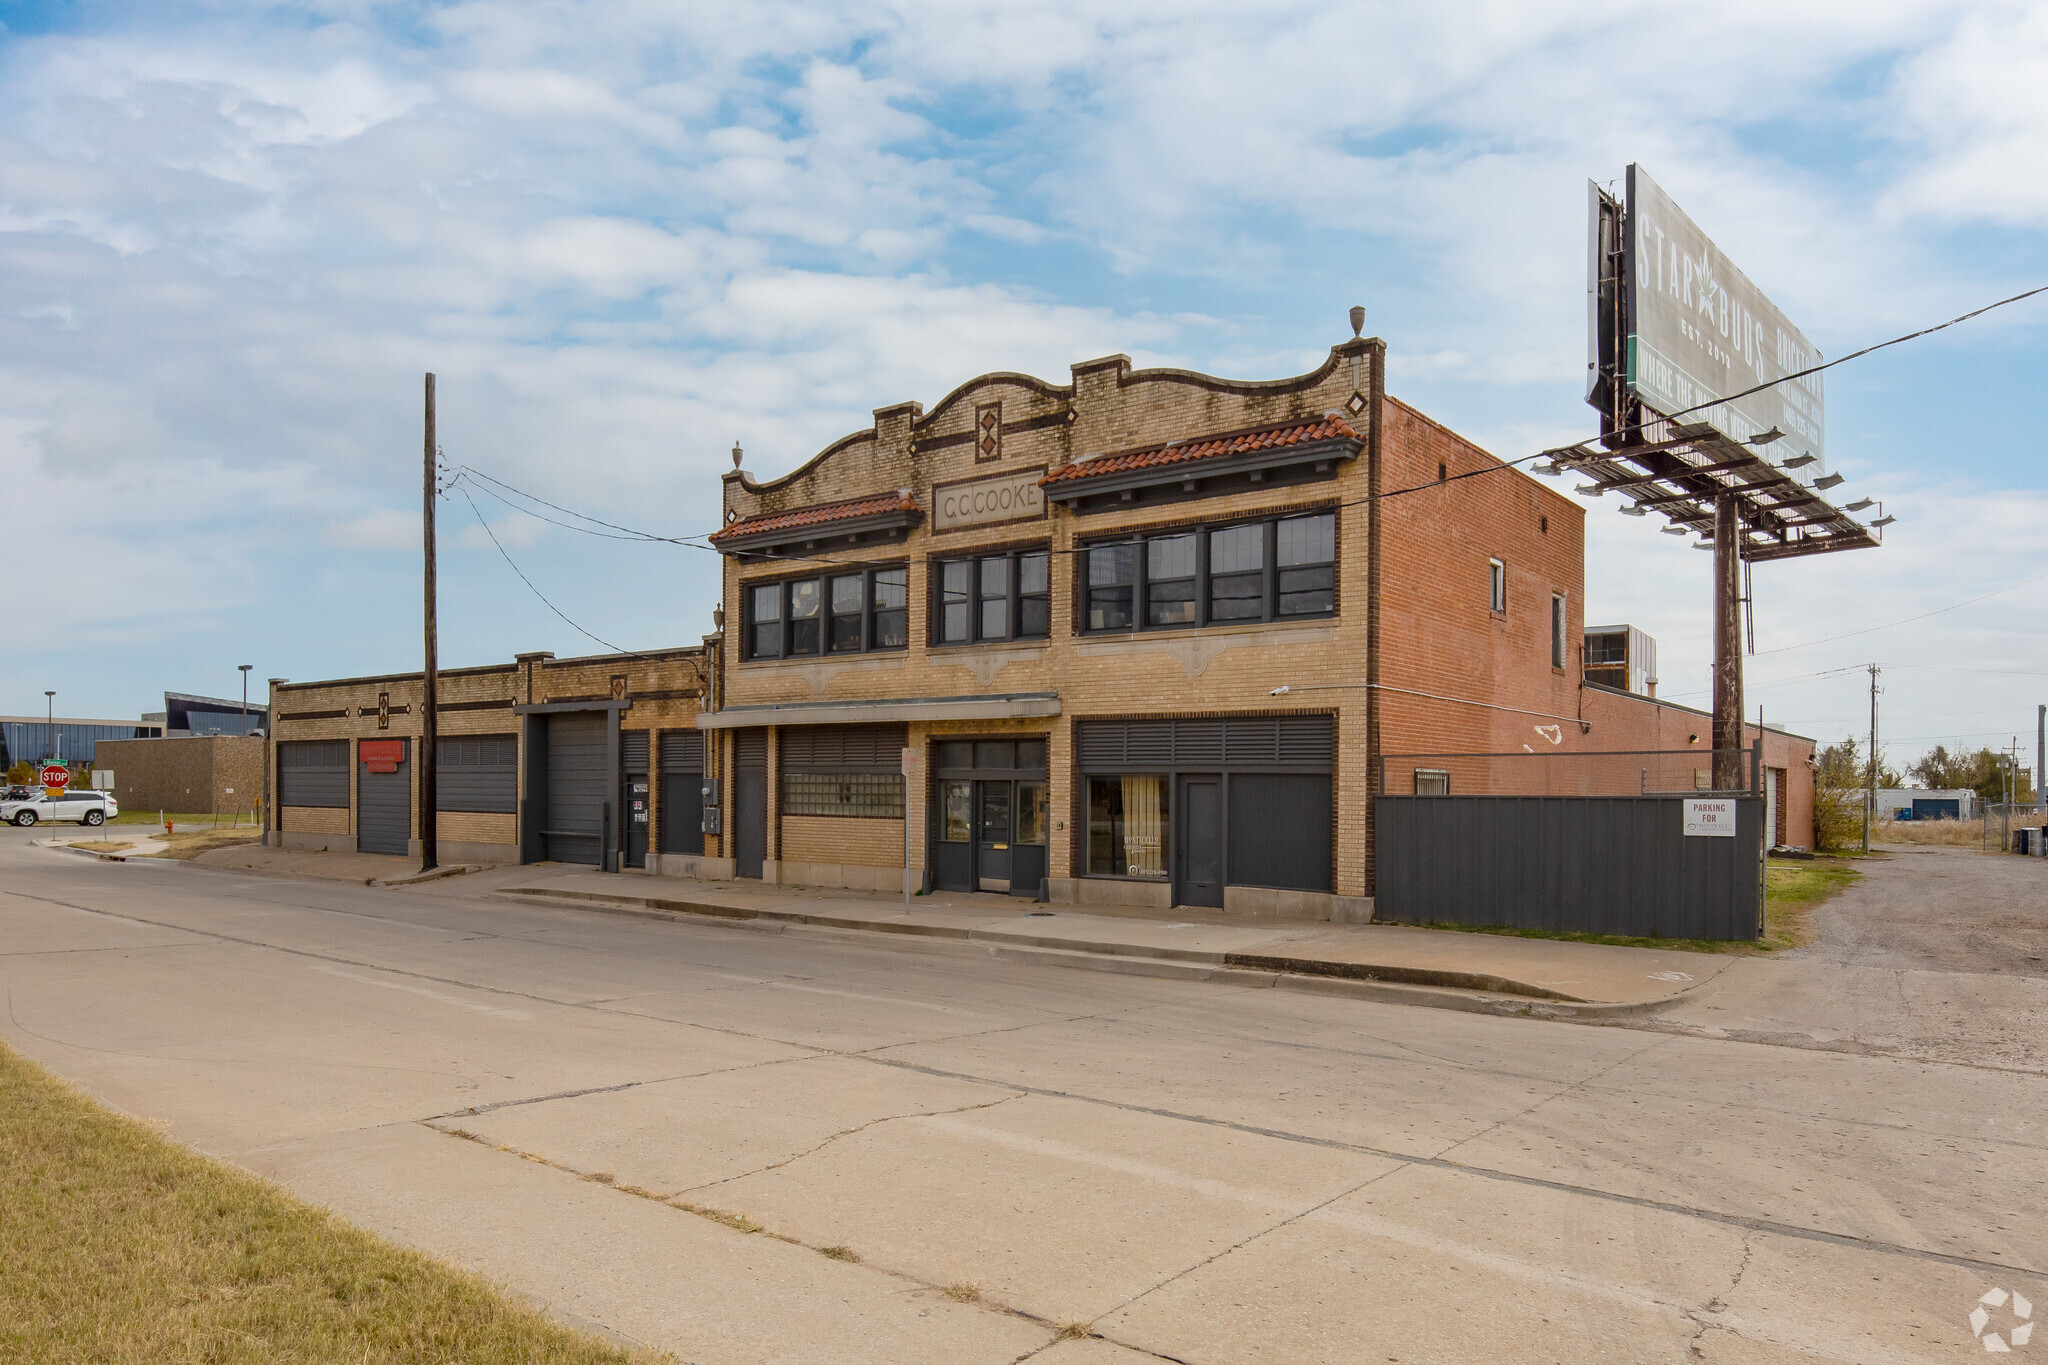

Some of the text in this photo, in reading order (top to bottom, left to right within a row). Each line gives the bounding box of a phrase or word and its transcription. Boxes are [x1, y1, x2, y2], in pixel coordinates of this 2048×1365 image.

[1639, 213, 1764, 383] STAR BUDS
[1681, 318, 1703, 349] EST.
[1777, 327, 1822, 401] BRICKTOWN
[1640, 346, 1673, 398] WHERE
[1676, 374, 1693, 410] THE
[1695, 388, 1728, 434] WAVING
[43, 772, 67, 781] STOP
[1693, 804, 1726, 812] PARKING
[1702, 814, 1717, 822] FOR
